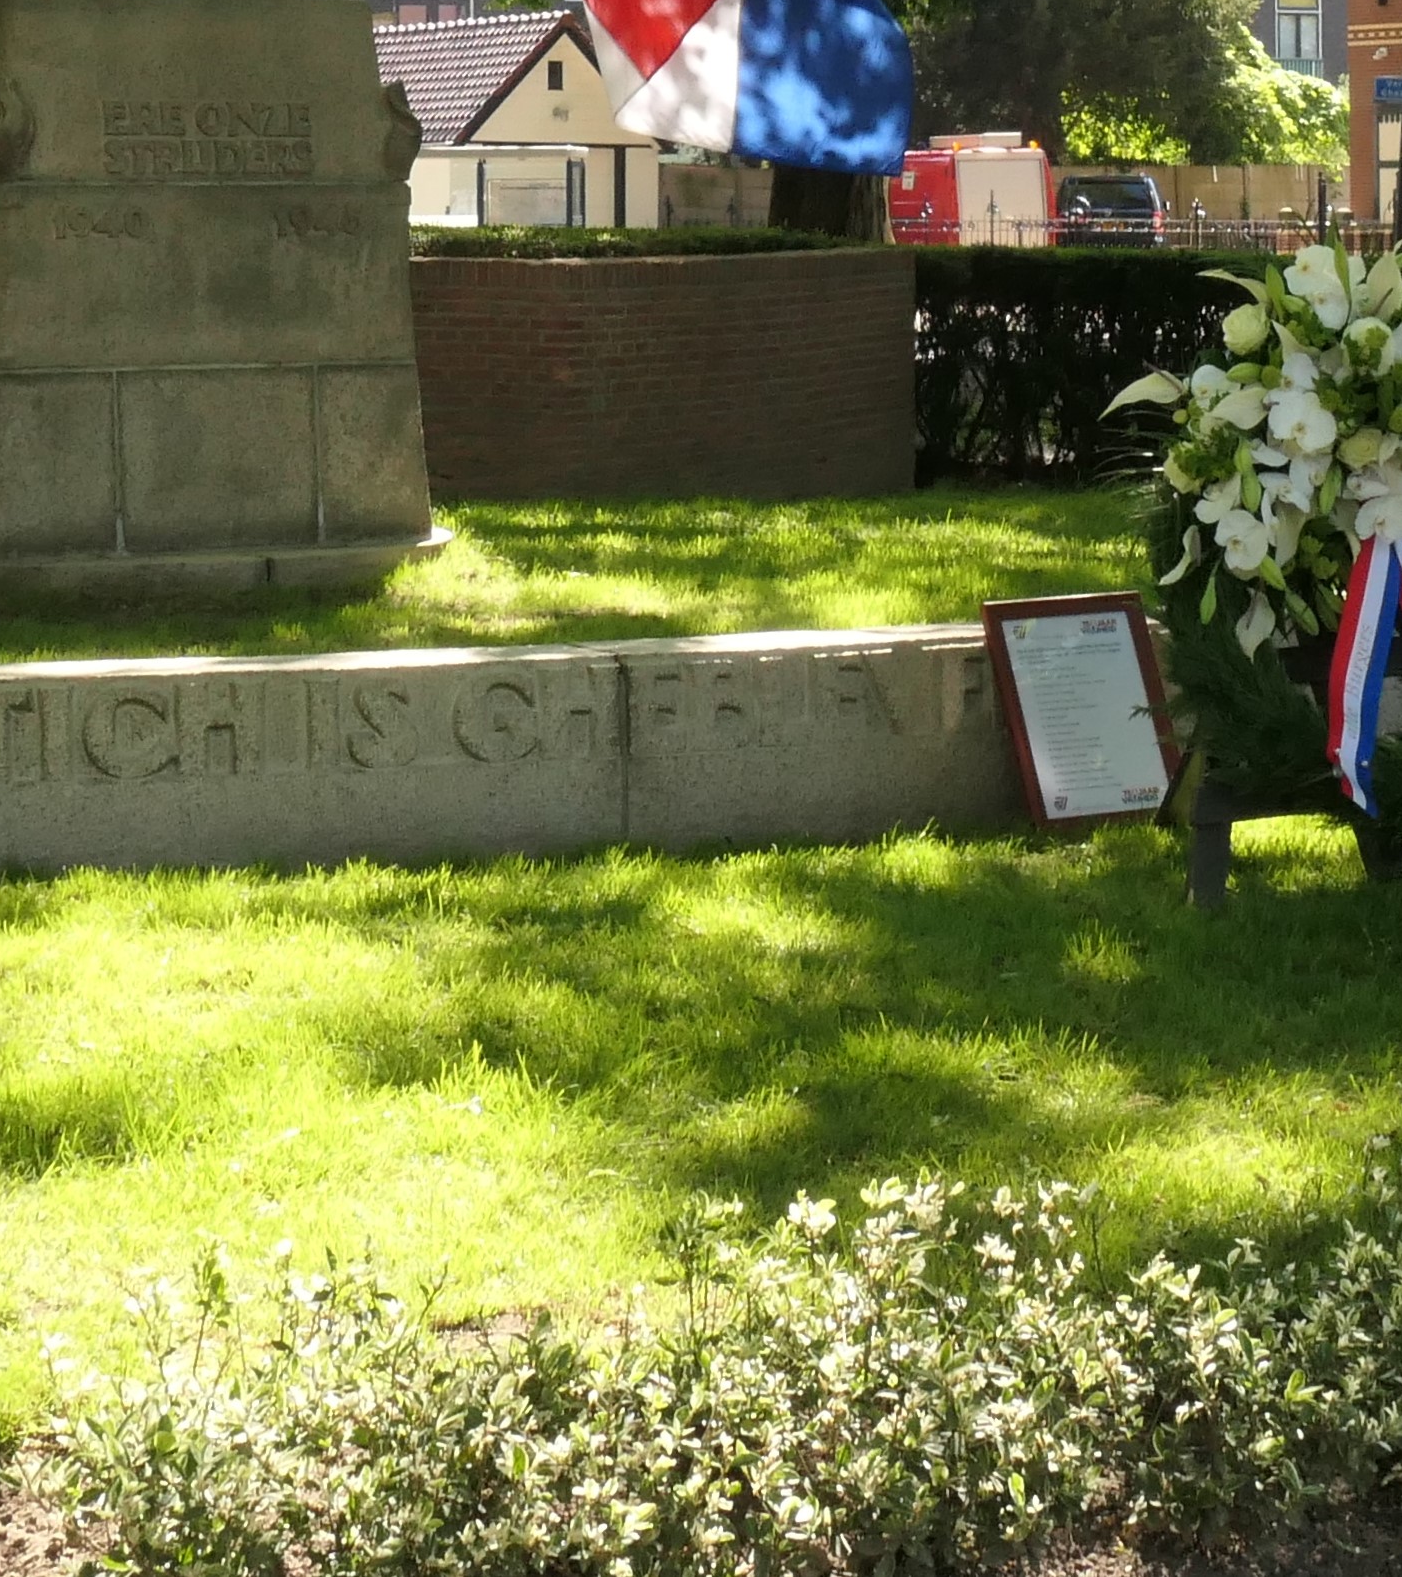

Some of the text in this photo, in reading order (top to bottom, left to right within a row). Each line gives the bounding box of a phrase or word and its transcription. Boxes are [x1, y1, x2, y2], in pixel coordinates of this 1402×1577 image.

[101, 99, 313, 137] ERE ONZE
[52, 204, 152, 240] 1940
[307, 675, 421, 771] IS
